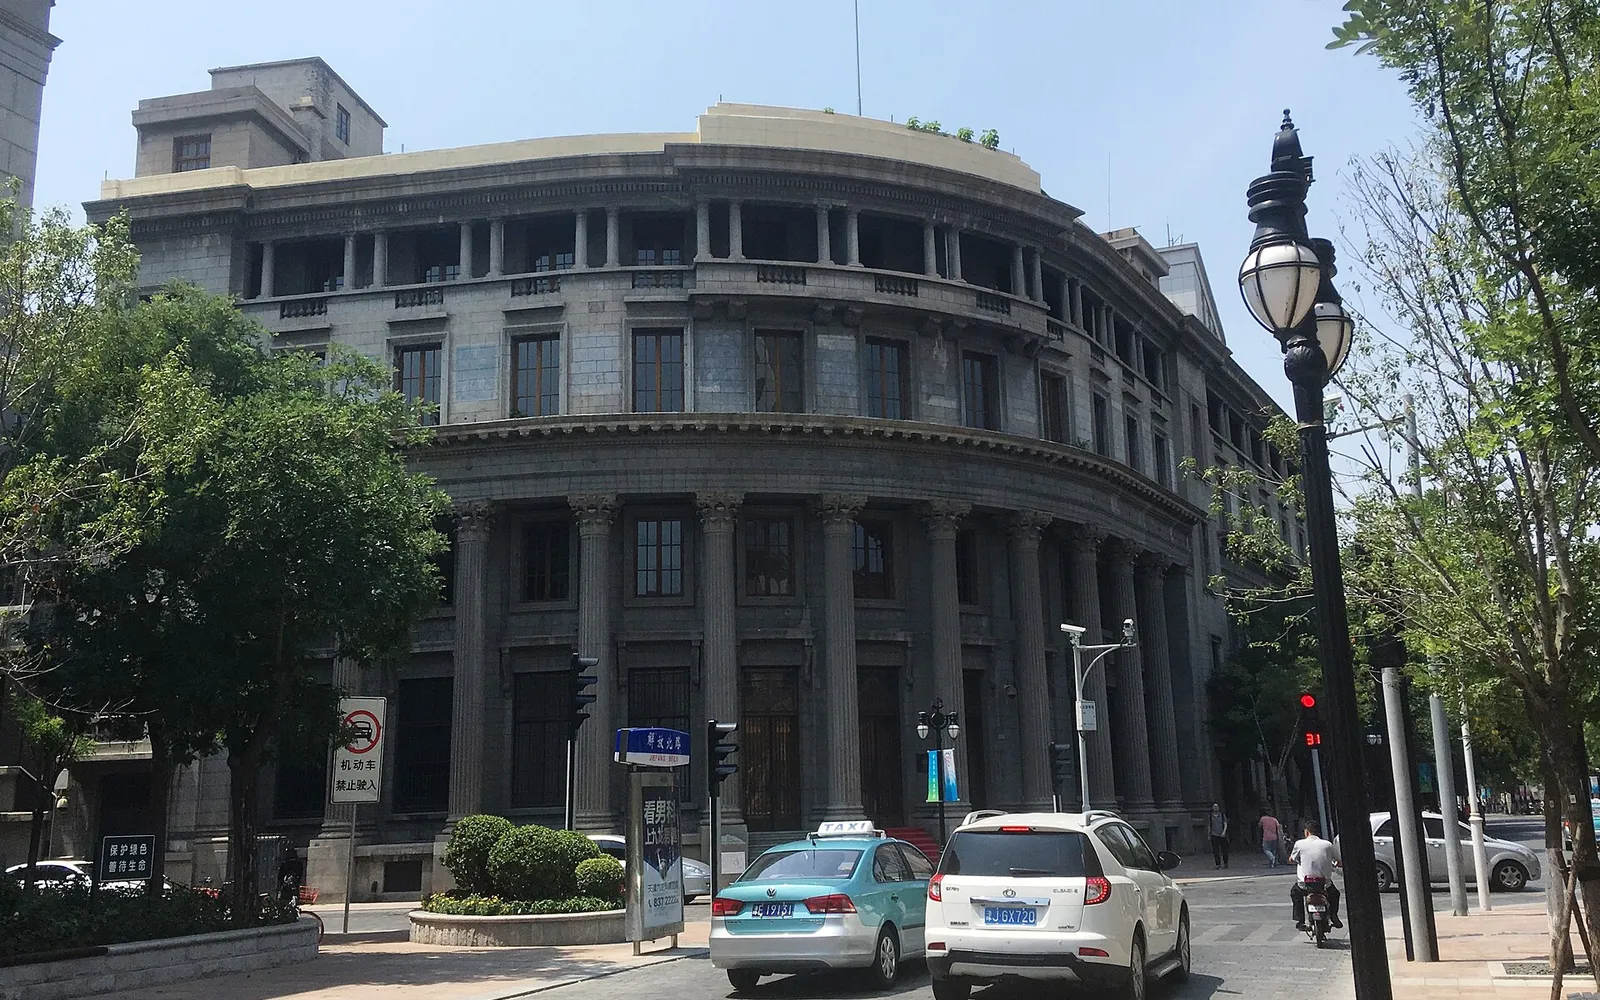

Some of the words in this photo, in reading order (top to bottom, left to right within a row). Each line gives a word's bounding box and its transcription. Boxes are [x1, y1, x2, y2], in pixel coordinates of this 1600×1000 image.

[1305, 733, 1321, 746] 31
[341, 759, 376, 771] 机动车
[335, 779, 377, 791] 禁止驶入
[824, 822, 866, 832] TAXI
[110, 843, 147, 857] 保护绿色
